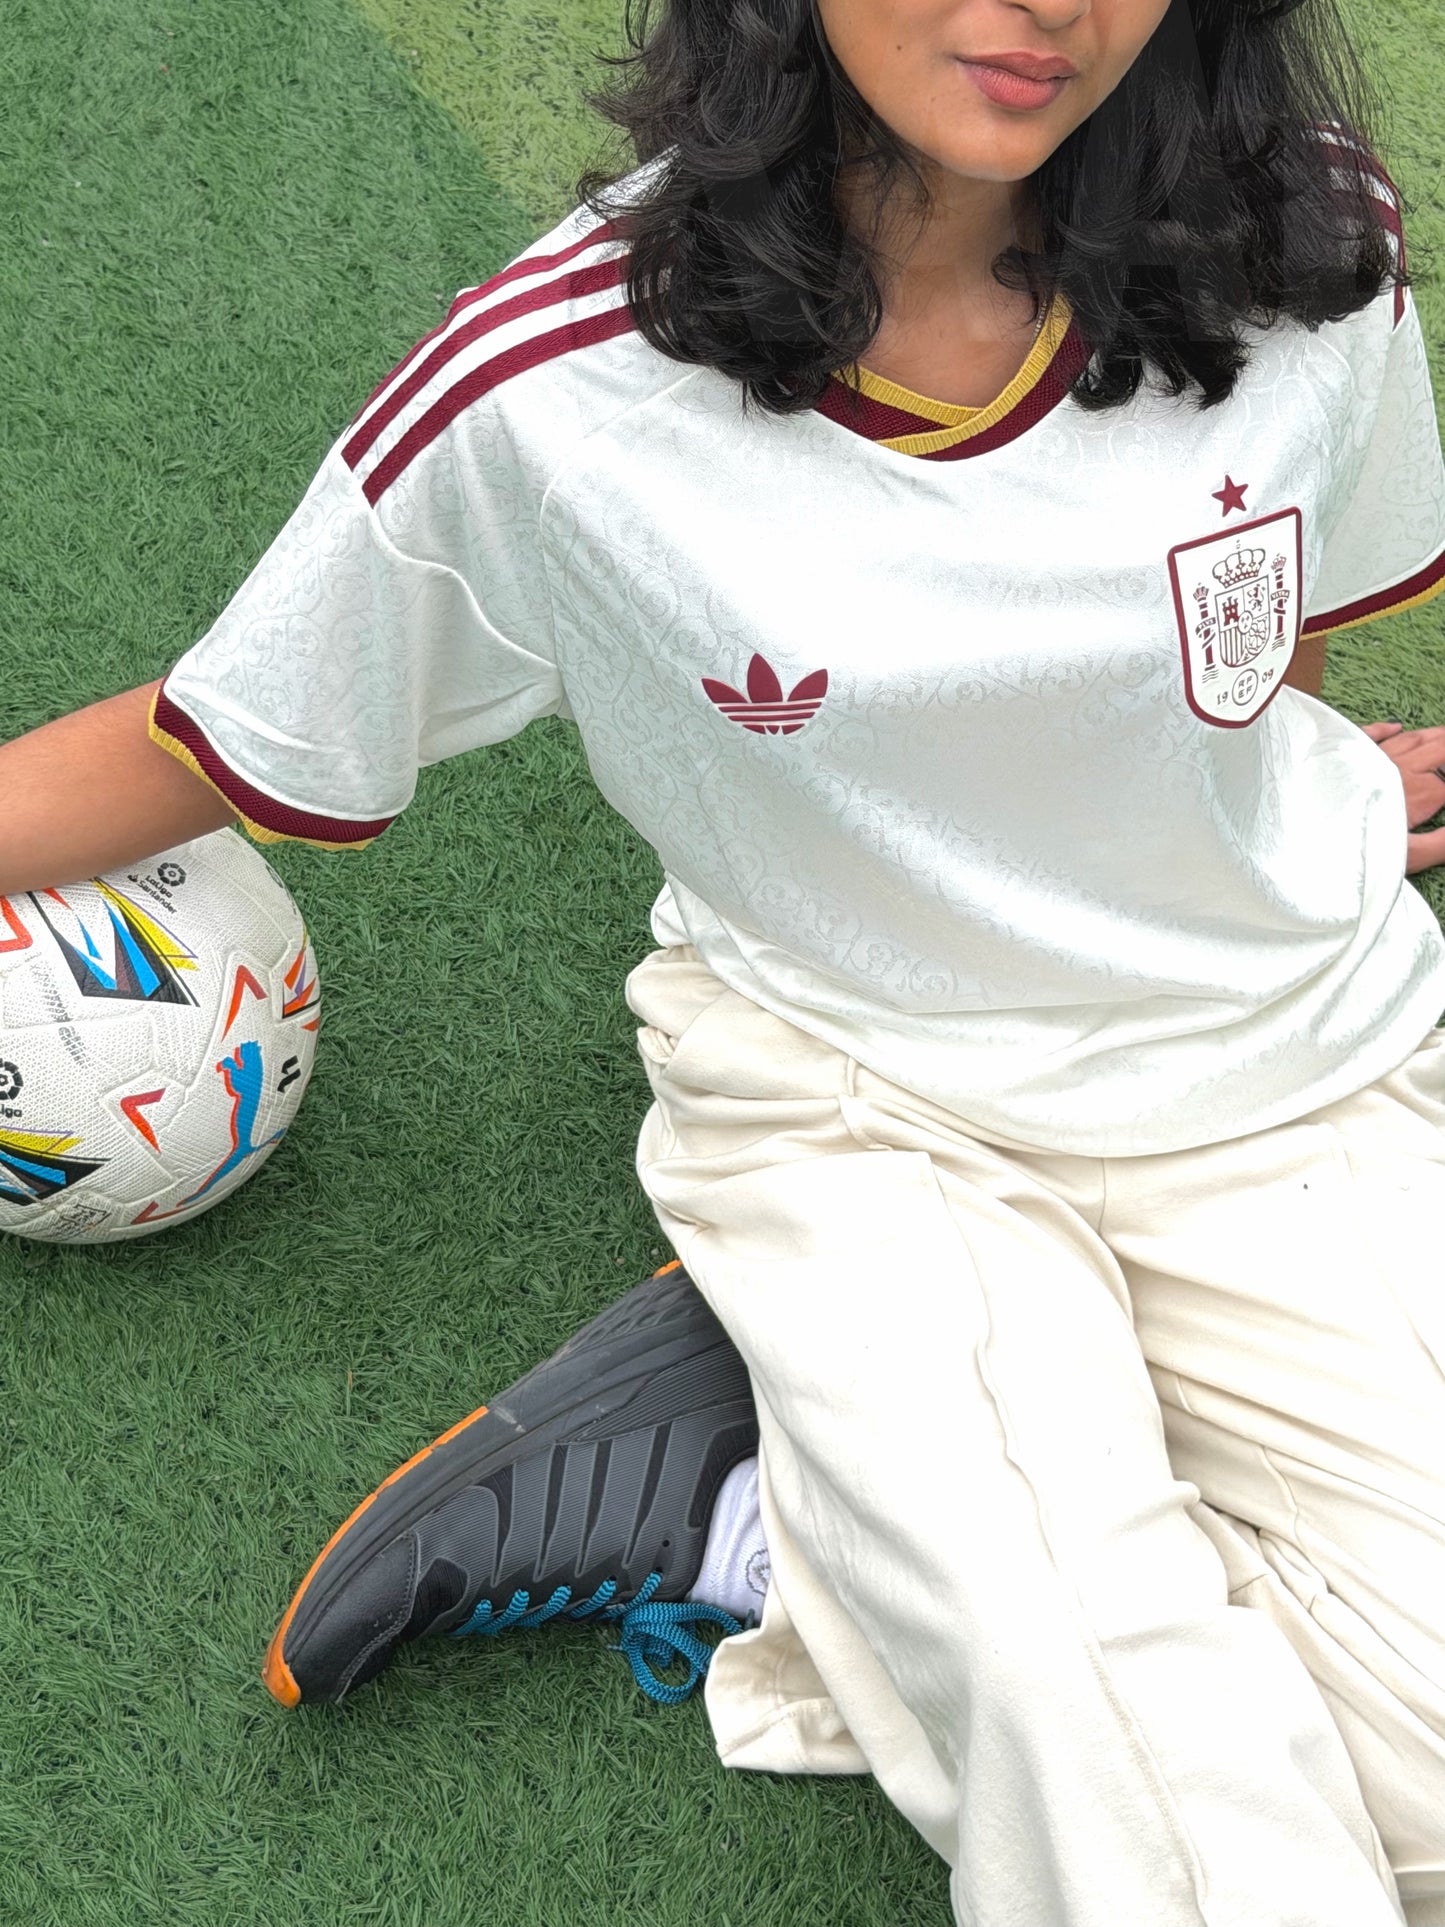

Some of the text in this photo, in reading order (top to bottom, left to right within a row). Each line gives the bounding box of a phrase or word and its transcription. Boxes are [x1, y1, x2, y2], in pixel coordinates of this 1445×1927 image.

[1261, 668, 1274, 683] 09
[1216, 691, 1228, 705] 19
[137, 880, 178, 915] Santander
[0, 1103, 23, 1118] iga
